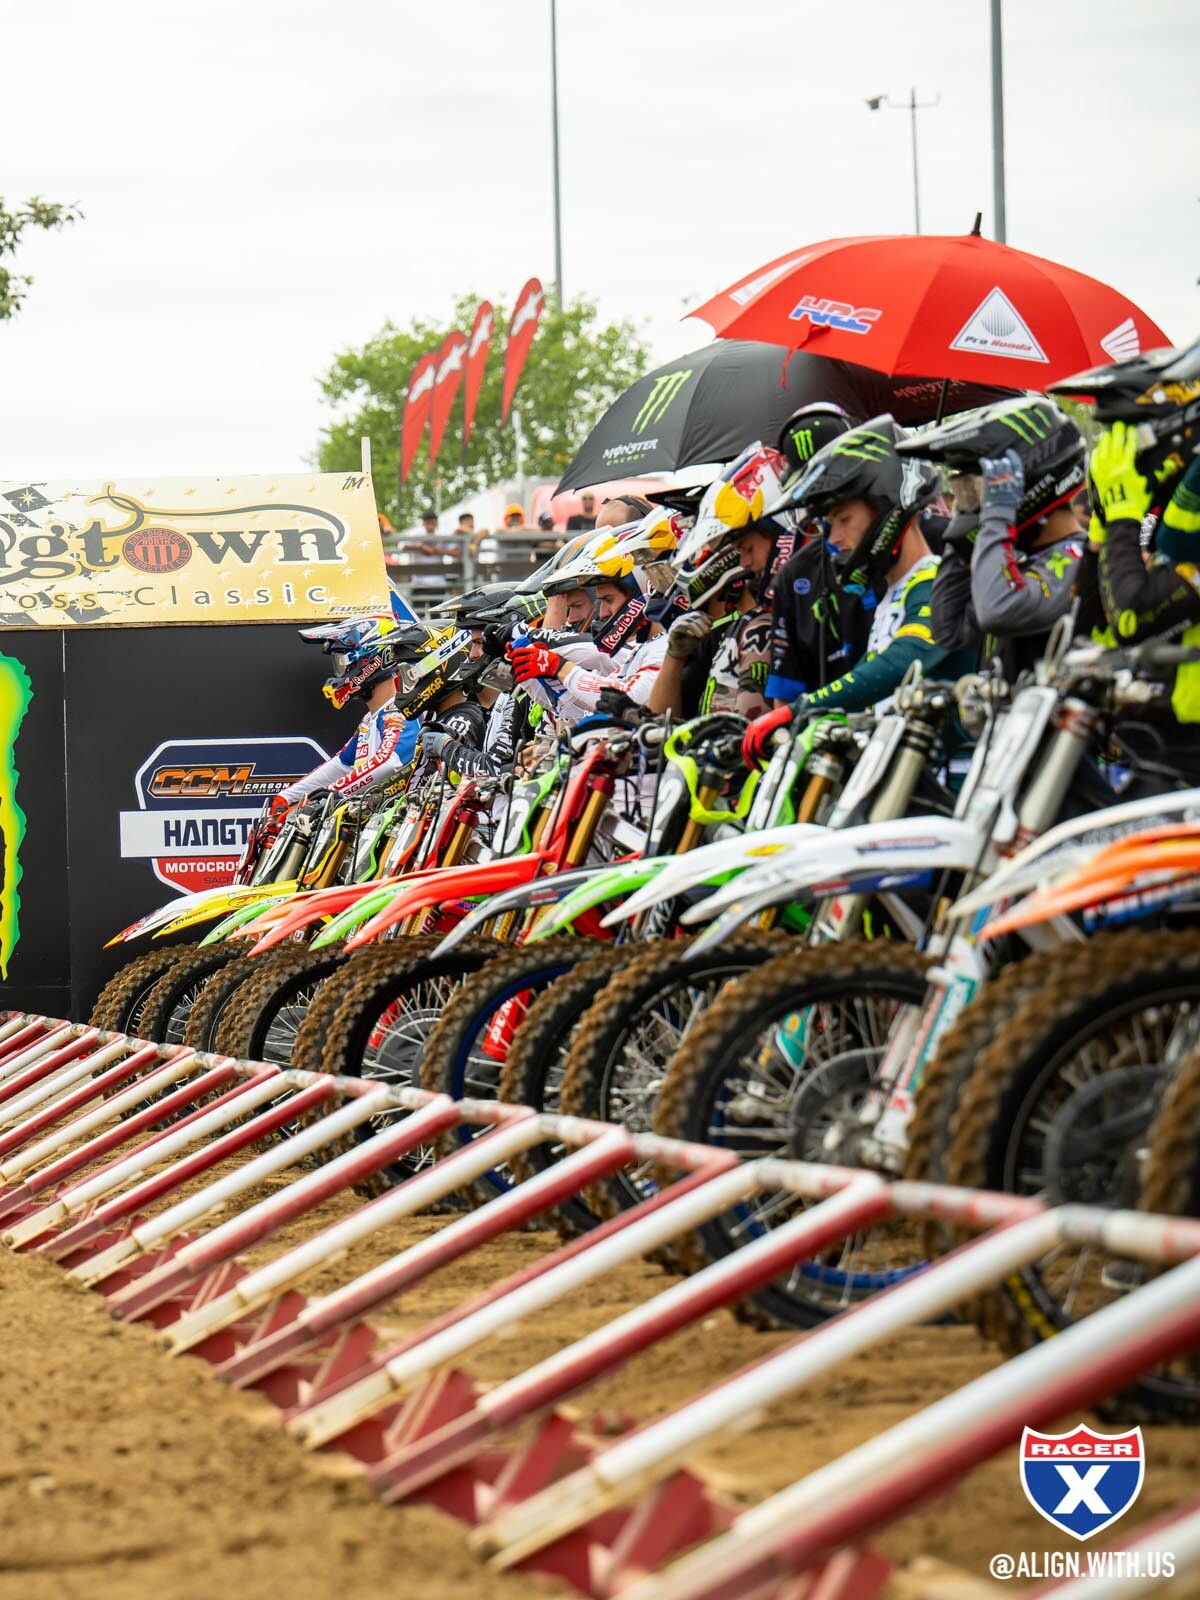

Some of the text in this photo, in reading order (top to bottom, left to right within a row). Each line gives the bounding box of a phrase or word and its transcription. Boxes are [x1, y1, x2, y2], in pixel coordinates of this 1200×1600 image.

[133, 583, 327, 606] Classic
[439, 630, 472, 660] SCO
[151, 767, 251, 796] CCM
[343, 775, 374, 797] SGAS
